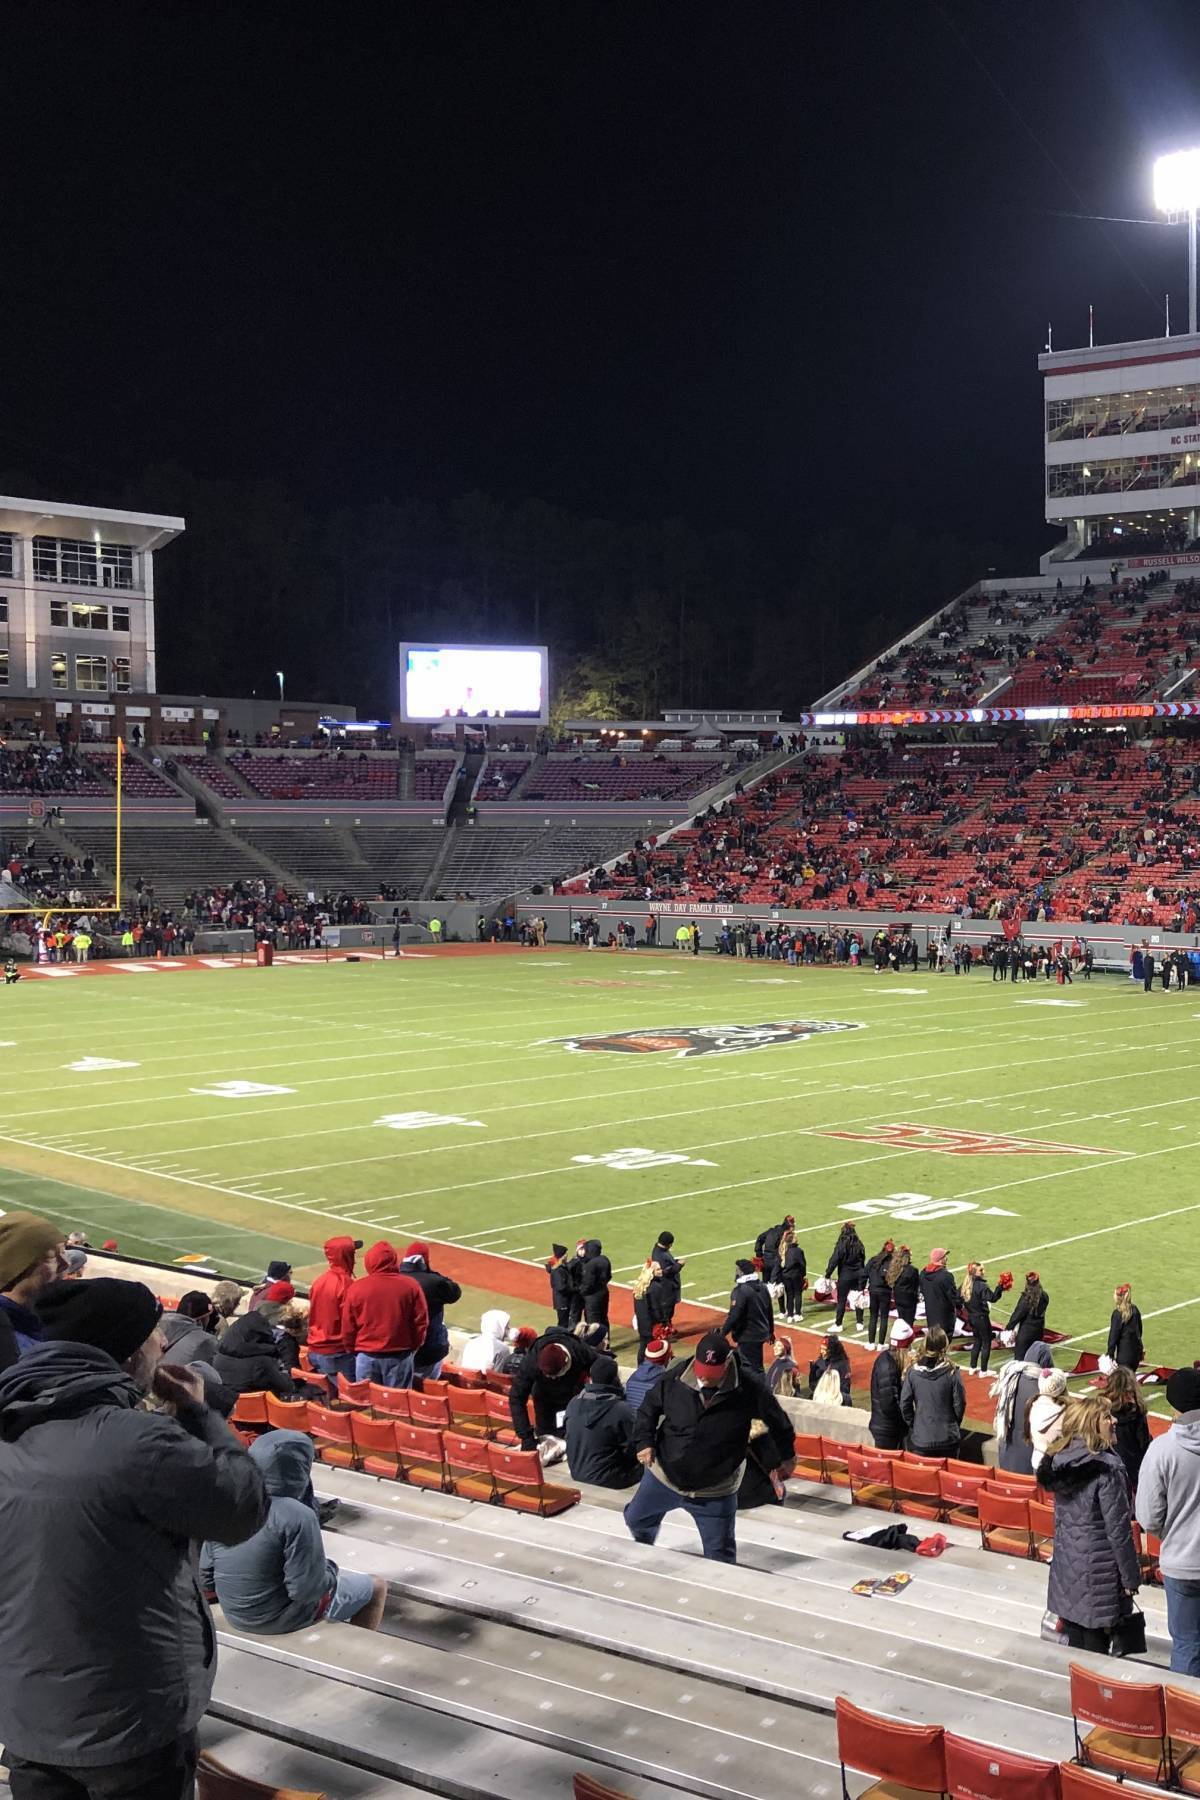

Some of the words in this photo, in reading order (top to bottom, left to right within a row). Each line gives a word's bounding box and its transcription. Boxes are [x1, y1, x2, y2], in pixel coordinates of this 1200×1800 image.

[1171, 436, 1181, 445] NC
[1143, 556, 1176, 567] RUSSELL
[650, 902, 672, 912] WAYNE
[674, 903, 687, 912] DAY
[689, 904, 712, 913] FAMILY
[715, 904, 733, 913] FIELD
[570, 1147, 690, 1170] 30
[837, 1192, 980, 1221] 20
